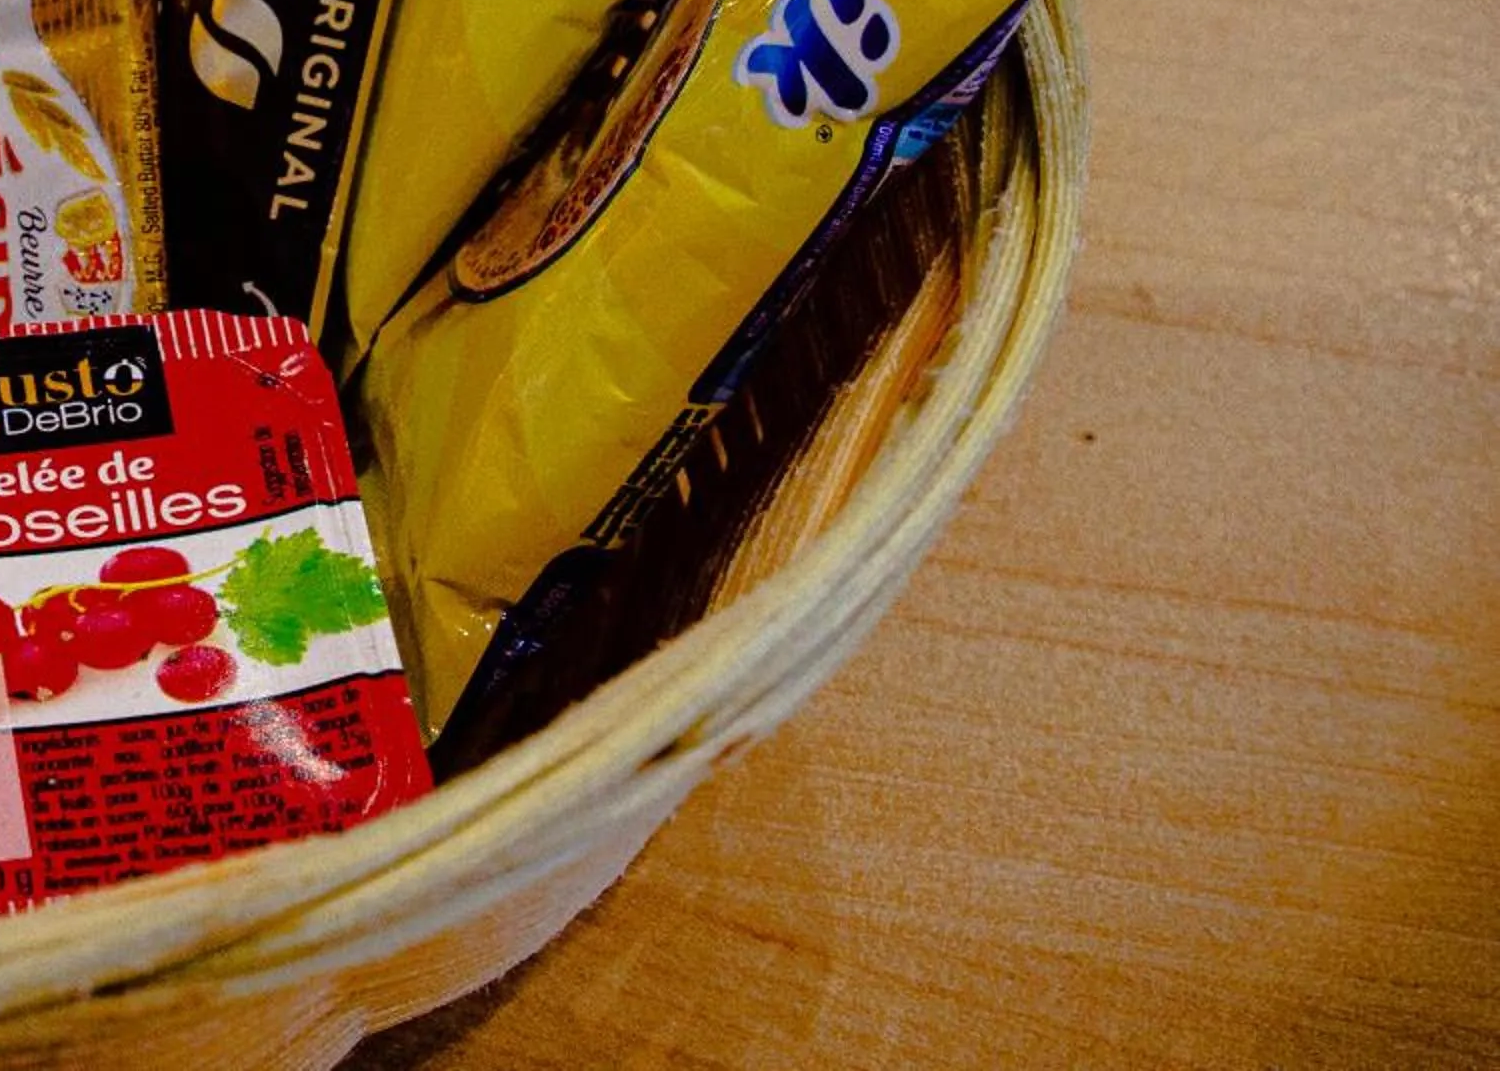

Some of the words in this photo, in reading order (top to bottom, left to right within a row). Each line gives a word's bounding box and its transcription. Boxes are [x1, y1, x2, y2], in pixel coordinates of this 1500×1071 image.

[16, 206, 49, 320] Beurre
[2, 399, 143, 436] DeBrio
[97, 450, 155, 485] de
[14, 869, 34, 897] g
